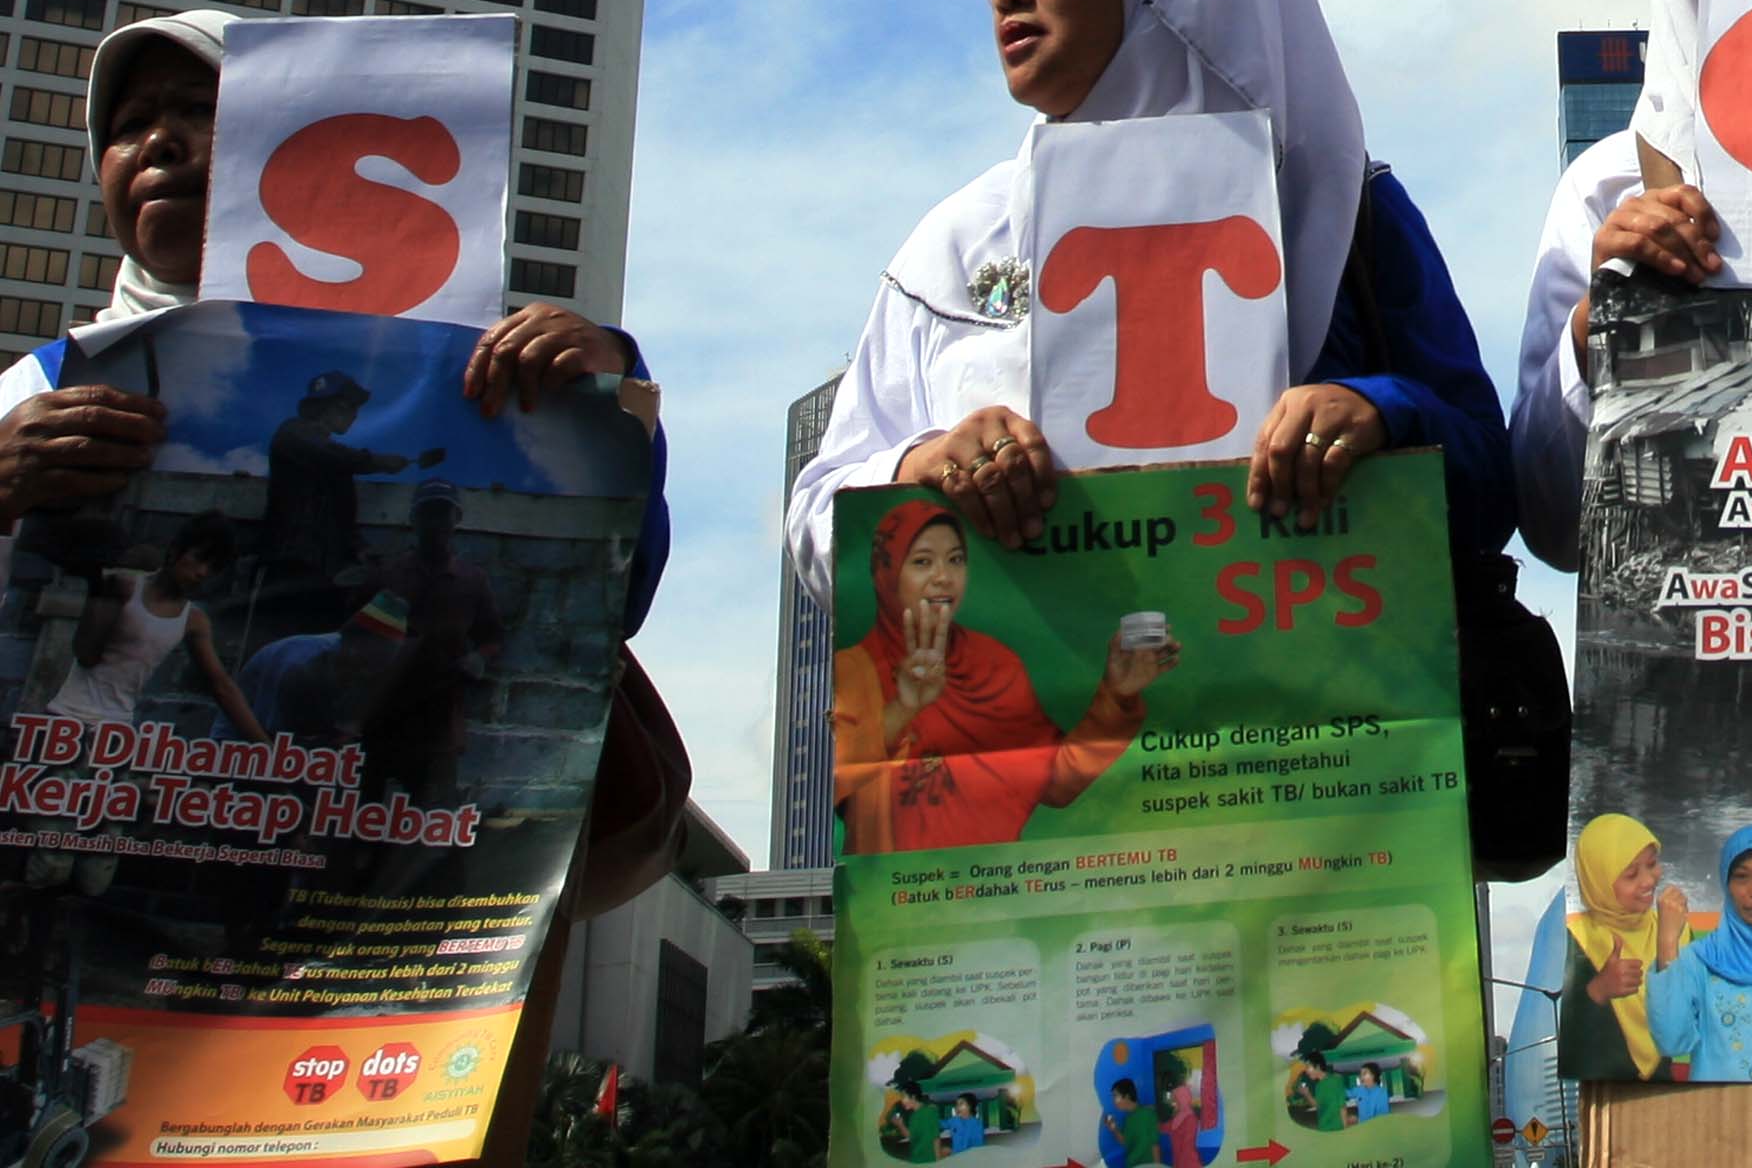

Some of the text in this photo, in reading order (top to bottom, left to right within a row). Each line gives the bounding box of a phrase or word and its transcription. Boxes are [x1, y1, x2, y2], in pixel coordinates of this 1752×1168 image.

[246, 113, 461, 316] S
[1040, 217, 1281, 449] T
[1193, 483, 1236, 546] 3
[1216, 554, 1384, 635] SPS
[14, 715, 362, 785] TB Dihambat
[1141, 714, 1389, 757] Cukup dengan SPS,
[1141, 750, 1350, 783] Kita bisa mengetahui
[0, 766, 479, 846] Kerja Tetap Hebat
[1141, 772, 1458, 814] suspek sakit TB/ bukan sakit TB
[39, 833, 60, 847] TB
[63, 834, 112, 850] Masih
[115, 836, 150, 854] Bisa
[152, 840, 215, 861] Bekerja
[217, 845, 278, 865] Seperti
[281, 849, 325, 867] Biasa
[892, 868, 945, 888] Suspek
[969, 862, 1012, 880] Orang
[1017, 858, 1070, 878] dengan
[1076, 850, 1152, 870] BERTEMU
[1157, 849, 1177, 863] TB
[891, 888, 940, 906] (Batuk
[944, 880, 1019, 901] bERdahak
[1025, 878, 1066, 894] TErus
[1084, 871, 1146, 889] menerus
[1151, 866, 1187, 883] lebih
[1192, 864, 1220, 880] dari
[1224, 863, 1234, 877] 2
[1240, 860, 1293, 879] minggu
[1299, 853, 1362, 873] MUngkin
[1368, 851, 1392, 867] TB)
[297, 915, 533, 935] dengan pengobatan yang teratur.
[292, 1058, 344, 1079] stop
[362, 1049, 418, 1075] dots
[295, 1083, 326, 1103] TB
[368, 1079, 398, 1099] TB
[156, 1141, 216, 1155] Hubungi
[218, 1141, 261, 1153] nomor
[263, 1139, 312, 1154] telepon
